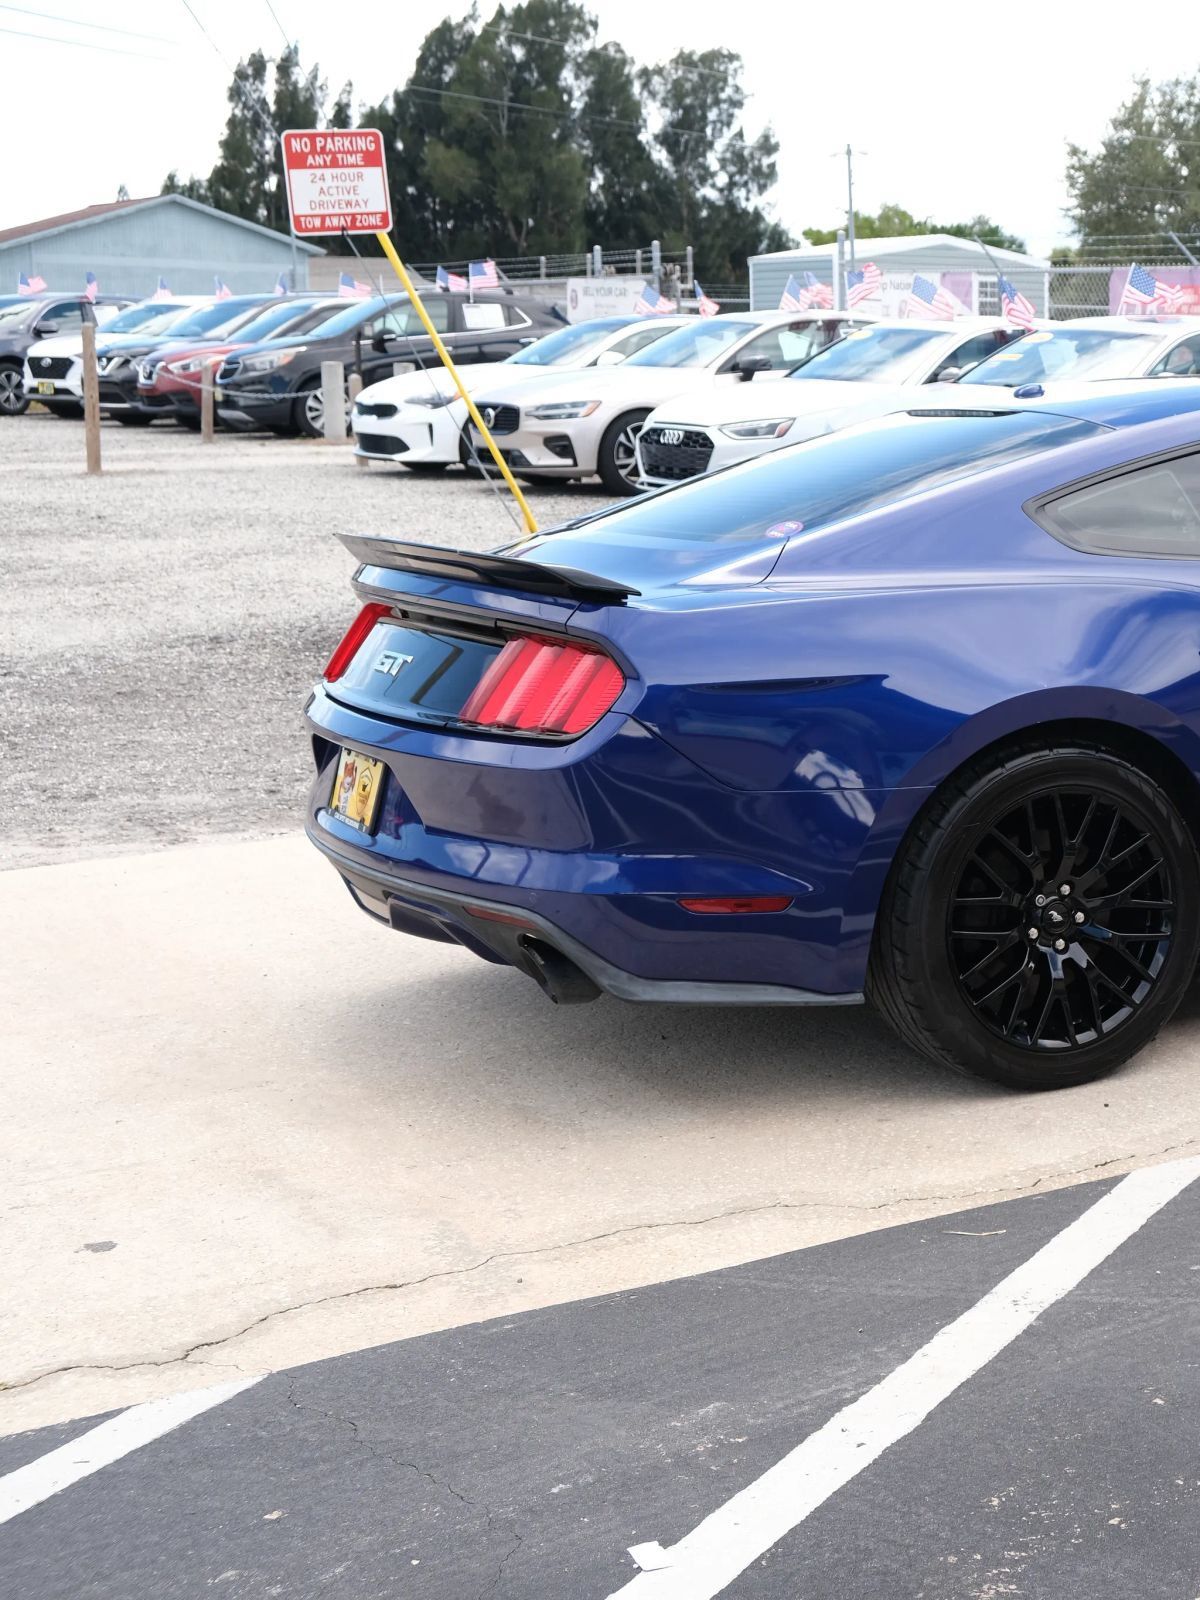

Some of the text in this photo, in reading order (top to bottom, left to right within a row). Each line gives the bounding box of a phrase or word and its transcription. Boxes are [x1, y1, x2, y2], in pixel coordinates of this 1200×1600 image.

[290, 136, 376, 153] NO PARKING
[306, 153, 365, 167] ANY TIME
[310, 171, 364, 184] 24 HOUR
[318, 185, 360, 197] ACTIVE
[309, 199, 369, 211] DRIVEWAY
[300, 214, 383, 229] TOW AWAY ZONE
[374, 650, 414, 677] GT
